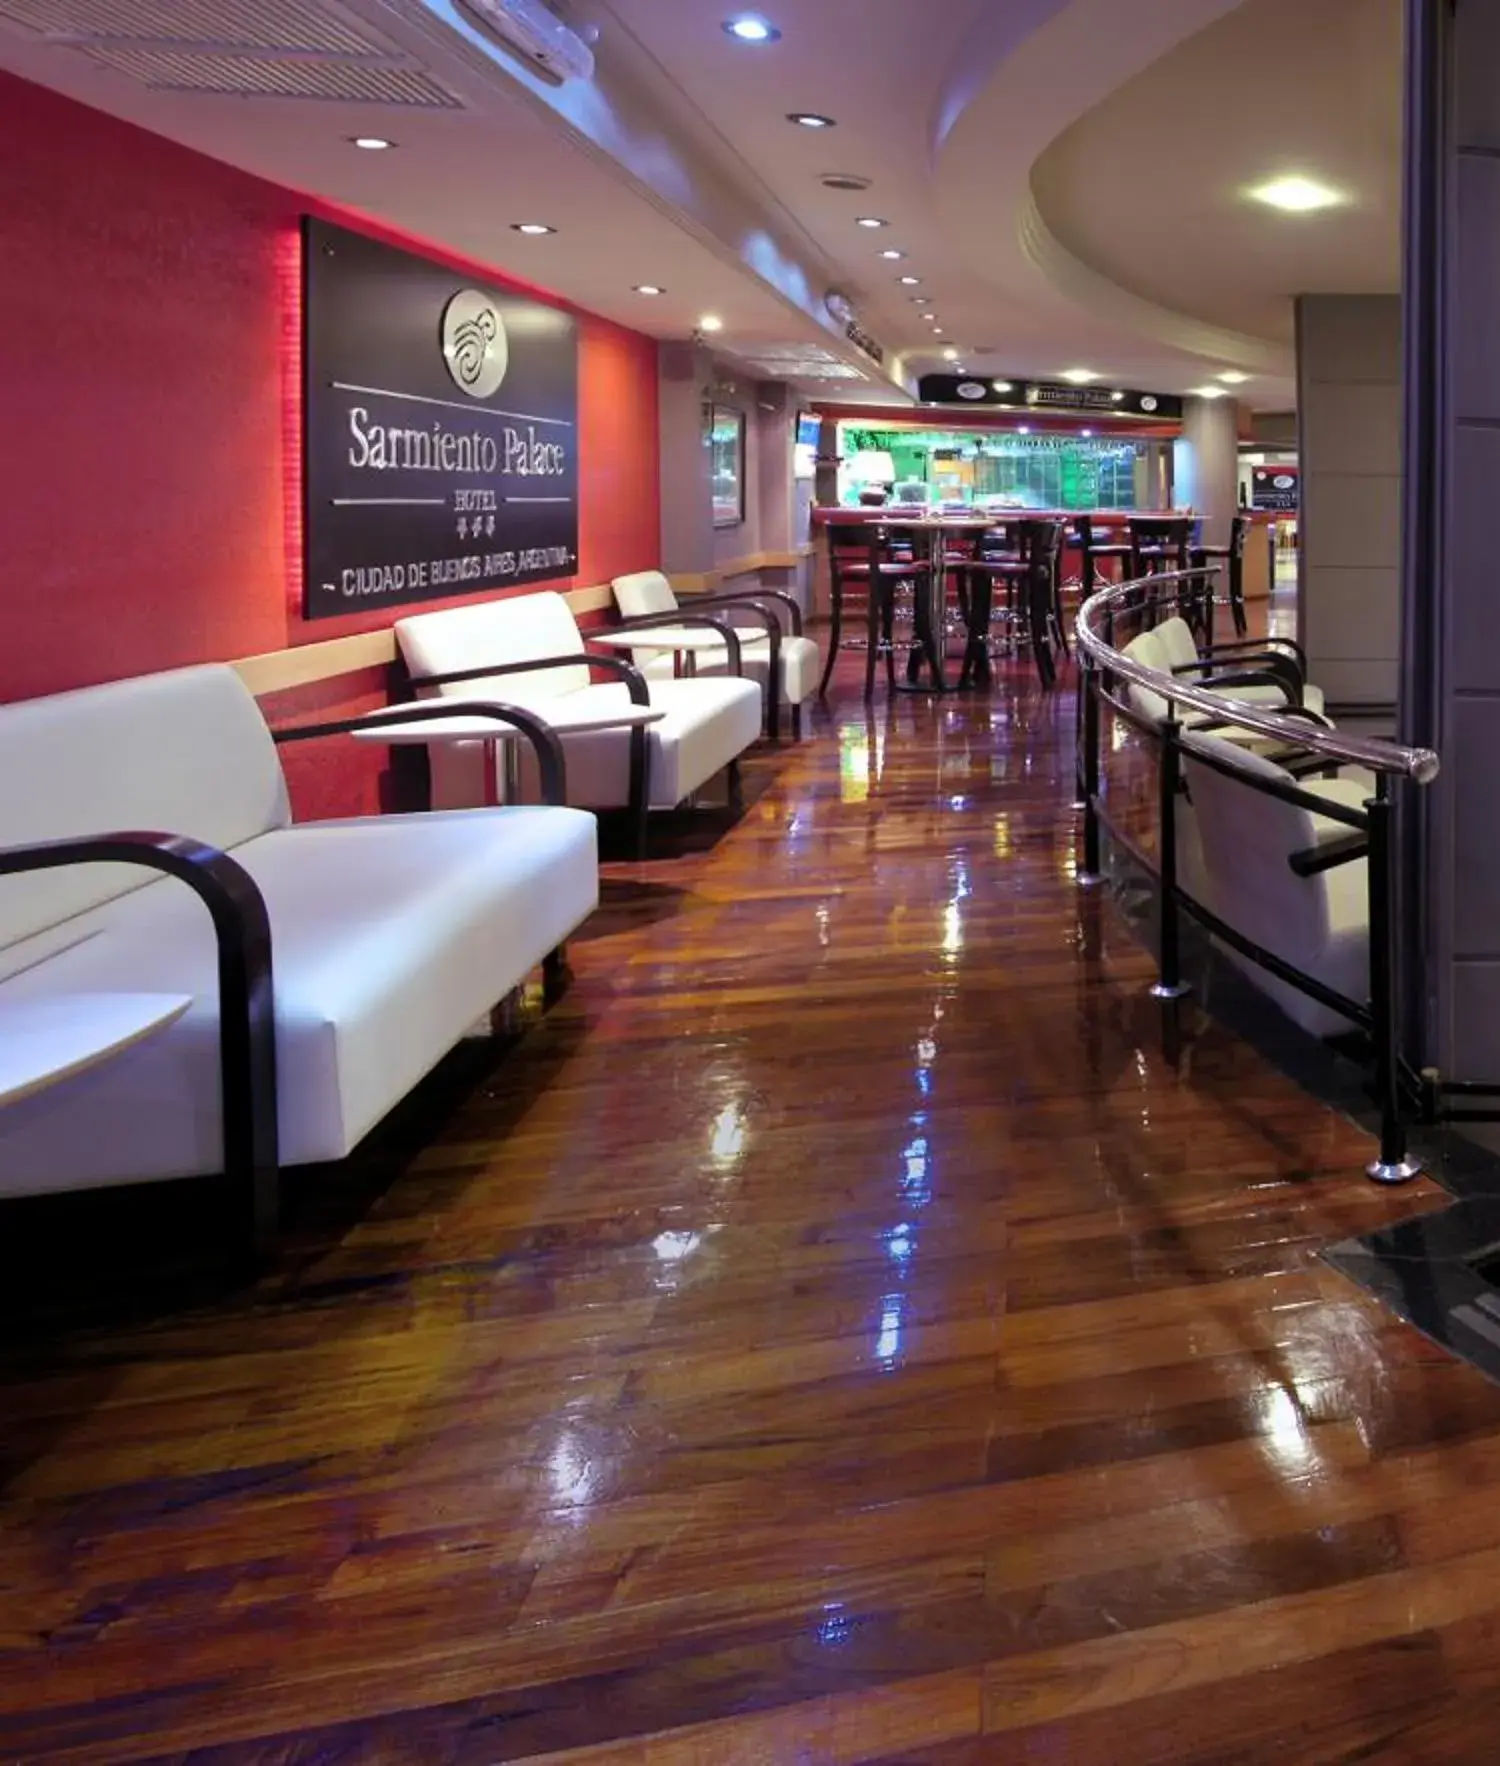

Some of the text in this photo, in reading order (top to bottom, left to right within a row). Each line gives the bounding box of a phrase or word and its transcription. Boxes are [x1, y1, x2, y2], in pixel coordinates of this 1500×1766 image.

[348, 406, 566, 477] Sarmiento Palace
[454, 489, 498, 512] HOTEL
[341, 565, 405, 597] CIUDAD
[408, 562, 428, 588] DE
[430, 556, 482, 585] BUENOS
